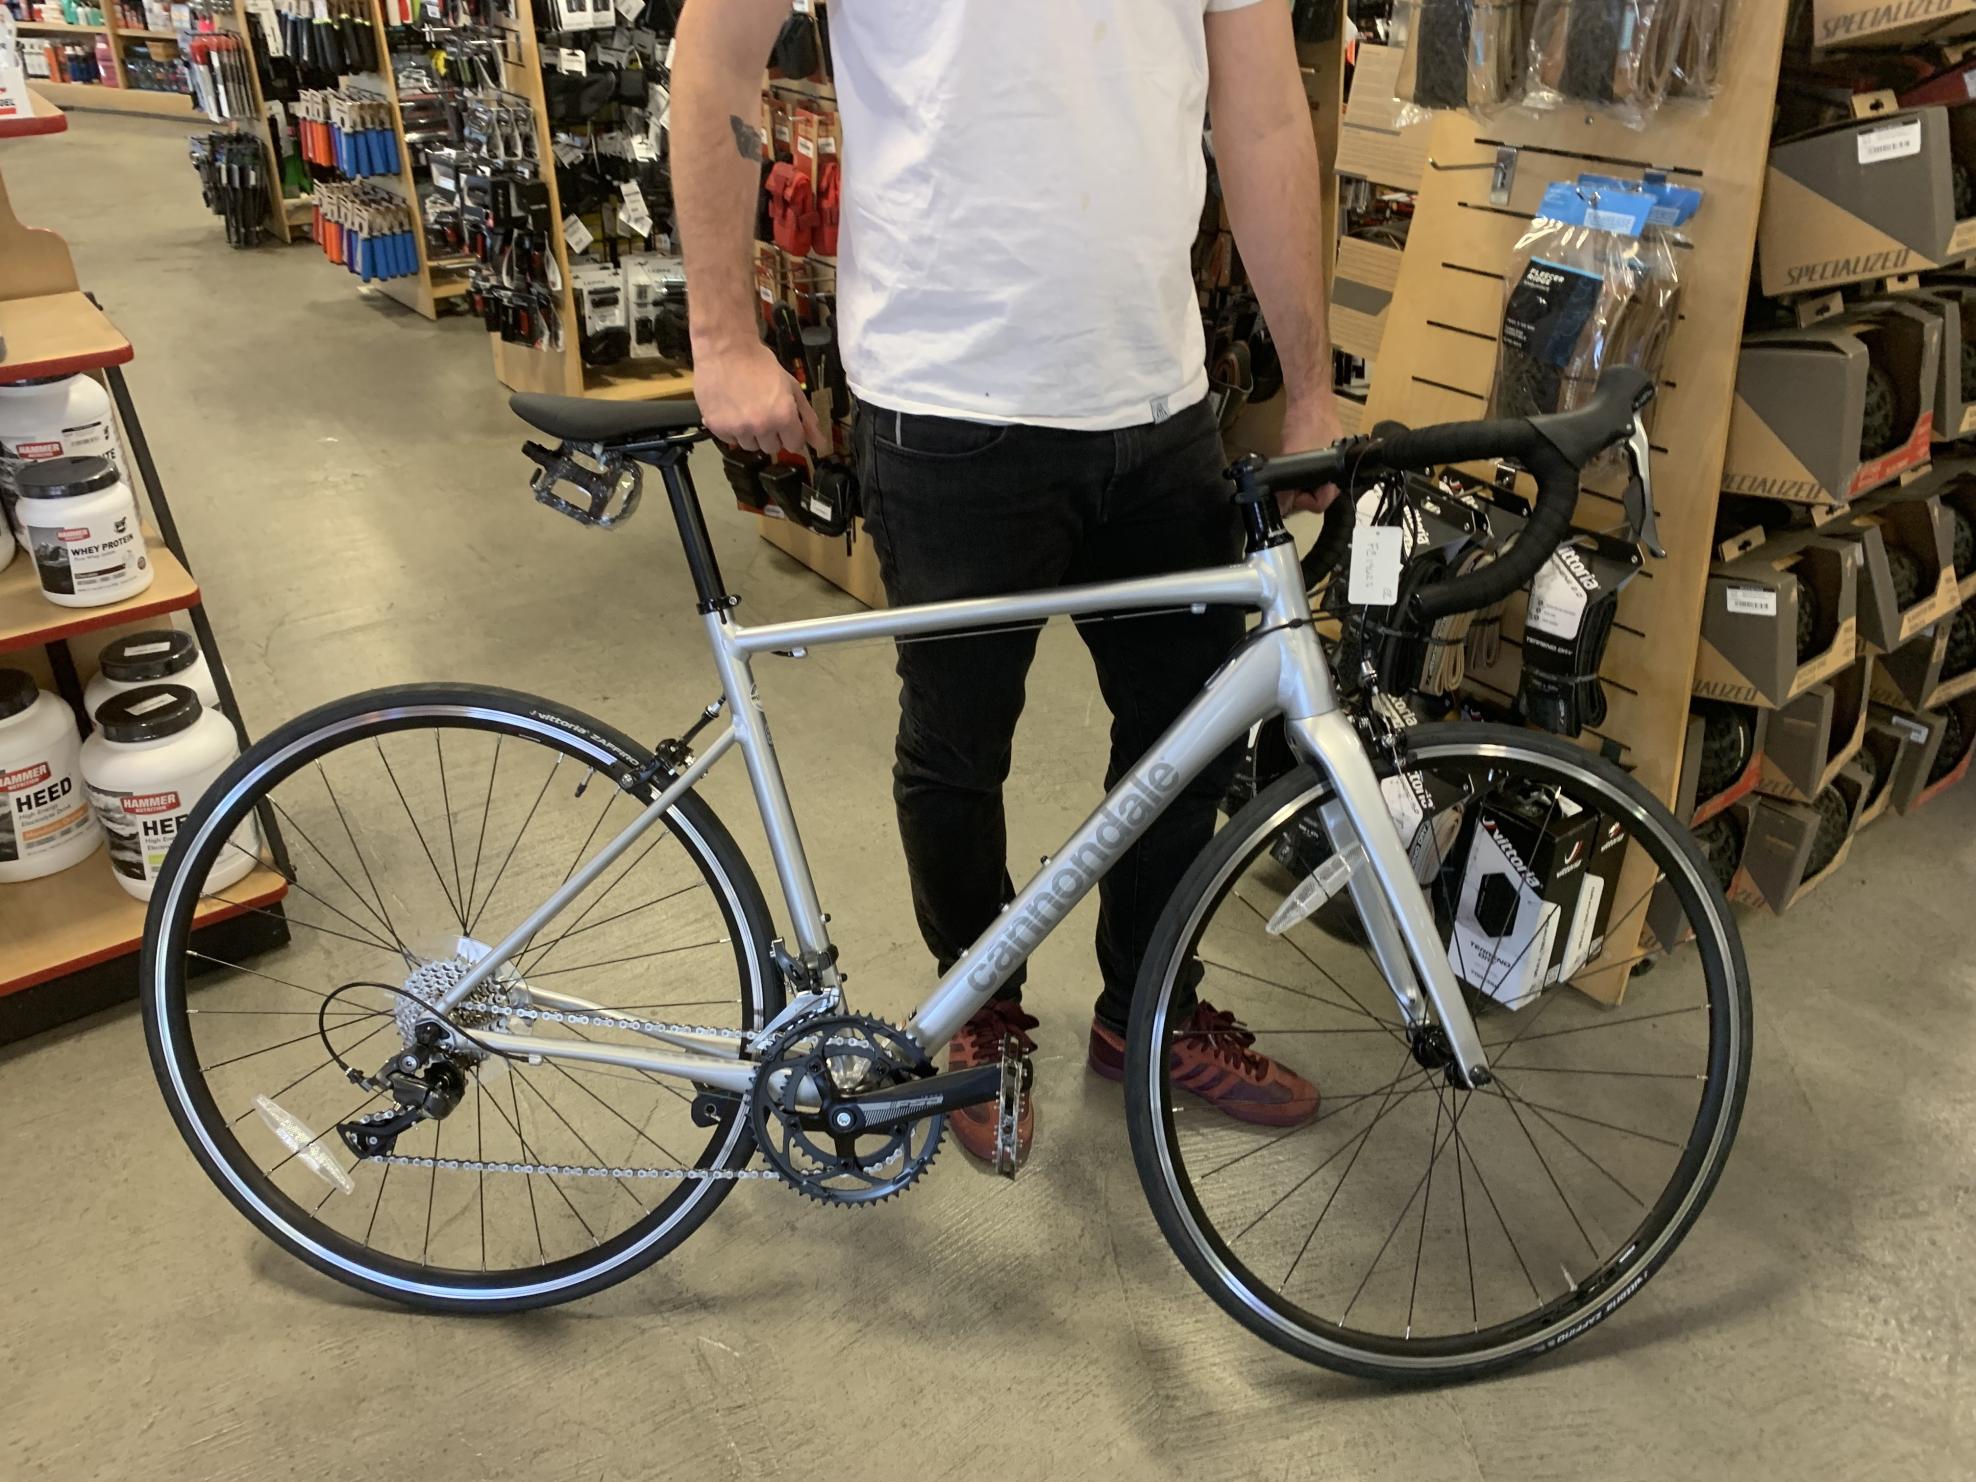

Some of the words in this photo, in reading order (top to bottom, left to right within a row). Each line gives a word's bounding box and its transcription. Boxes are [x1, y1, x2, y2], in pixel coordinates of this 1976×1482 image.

[1785, 248, 1911, 286] SPECIALIZED
[1725, 474, 1822, 499] ECIALIZED
[71, 545, 100, 556] WHEY
[101, 533, 134, 551] PROTEIN
[1557, 547, 1599, 591] ittoria
[538, 712, 587, 735] vittoria
[590, 733, 640, 766] ZAFFIRO
[16, 777, 72, 813] HEED
[123, 793, 176, 809] HAMMER
[966, 761, 1180, 993] cannondale
[1492, 828, 1541, 888] vittoria
